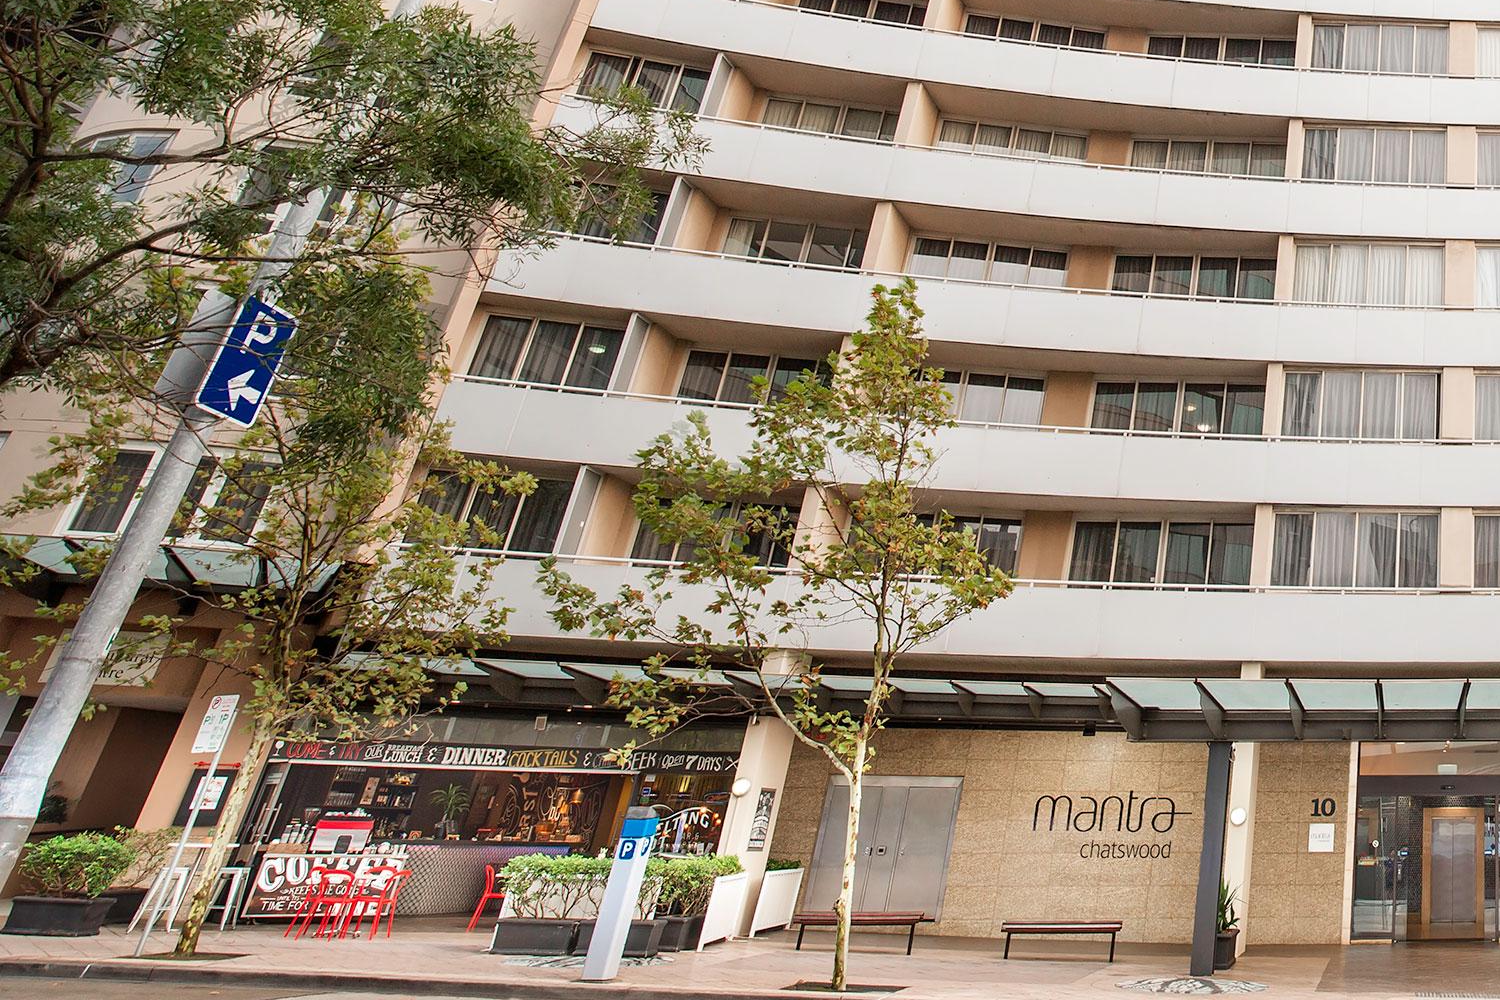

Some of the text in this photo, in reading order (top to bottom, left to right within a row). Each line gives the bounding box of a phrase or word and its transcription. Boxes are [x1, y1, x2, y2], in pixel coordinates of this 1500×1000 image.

[240, 311, 277, 354] P
[382, 750, 422, 762] LUNCH
[441, 747, 507, 766] DINNER
[685, 754, 699, 770] 7
[696, 755, 722, 771] DAYS
[1032, 790, 1192, 833] mantra
[1310, 797, 1336, 817] 10
[621, 842, 634, 857] P
[1079, 840, 1172, 859] chatswood
[261, 901, 286, 911] TIME
